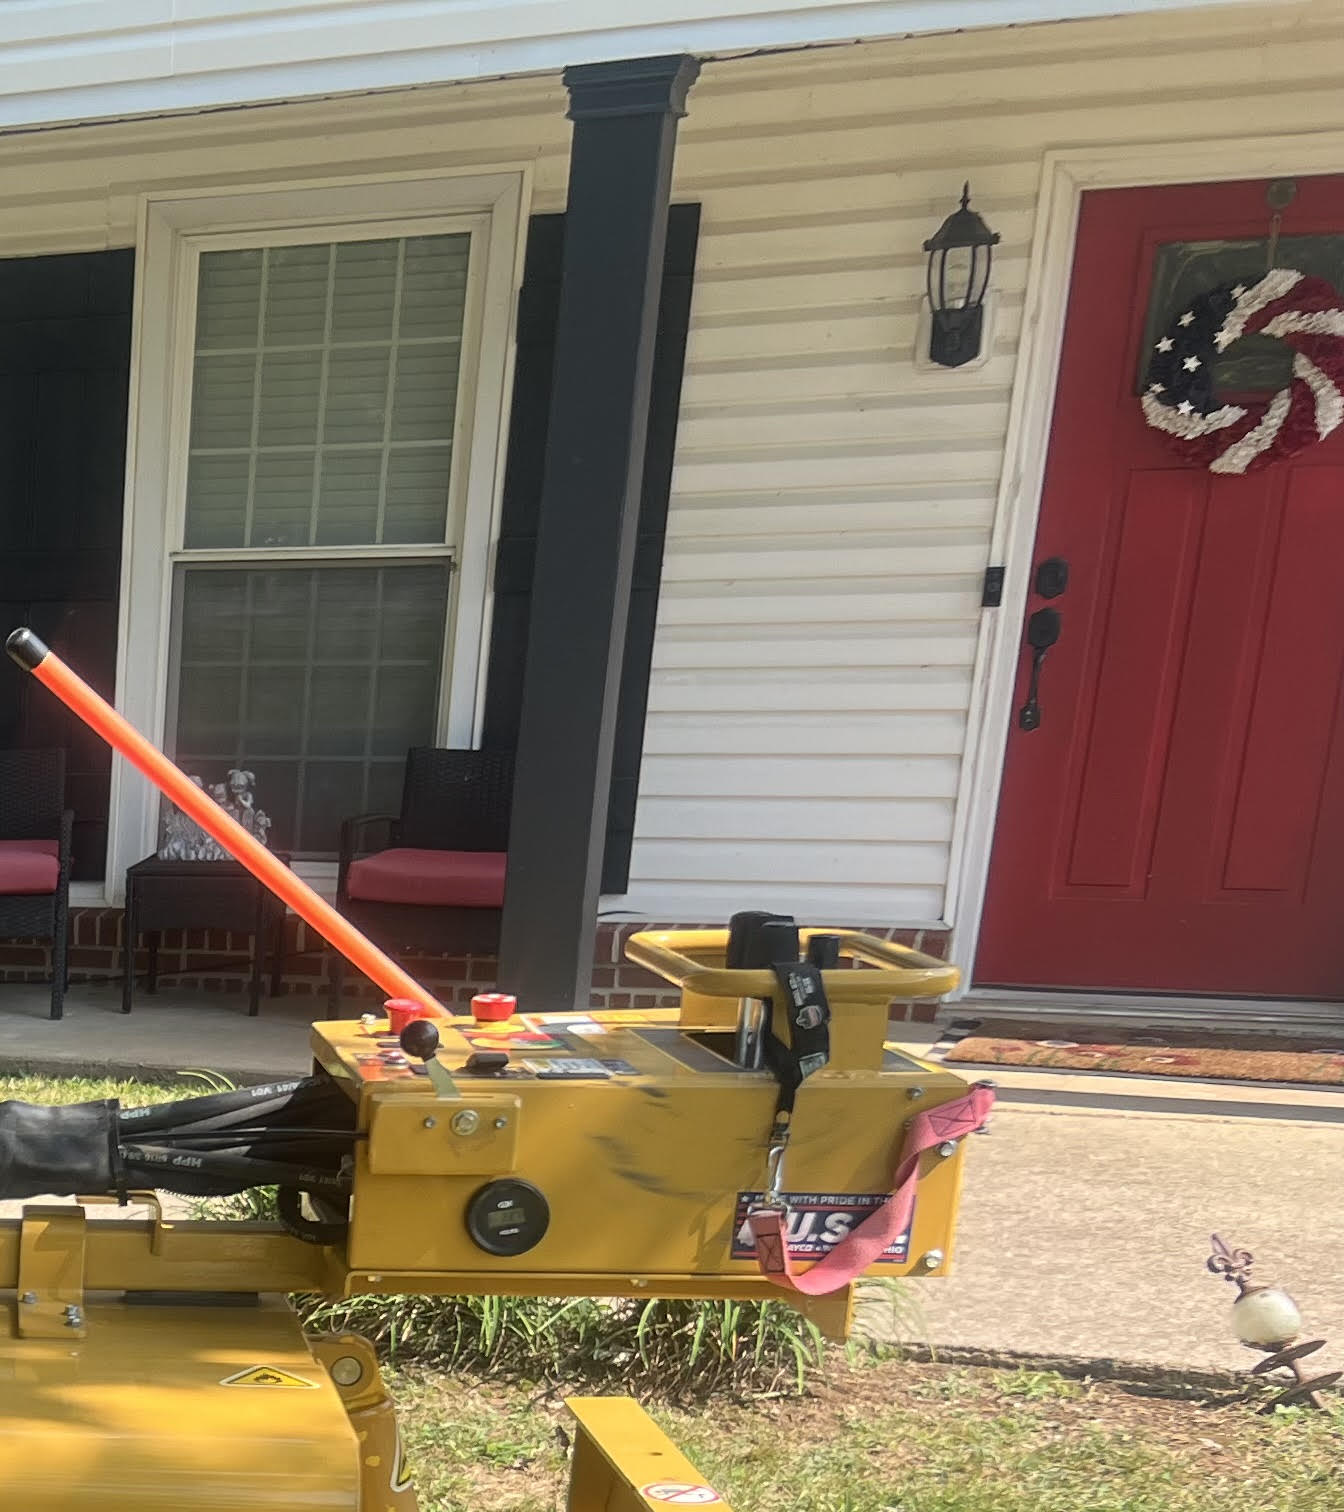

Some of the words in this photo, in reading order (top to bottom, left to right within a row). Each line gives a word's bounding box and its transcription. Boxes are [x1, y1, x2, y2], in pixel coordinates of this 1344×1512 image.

[789, 1194, 817, 1204] WITH
[820, 1195, 855, 1206] PRIDE
[858, 1196, 872, 1205] IN
[874, 1196, 890, 1206] TH
